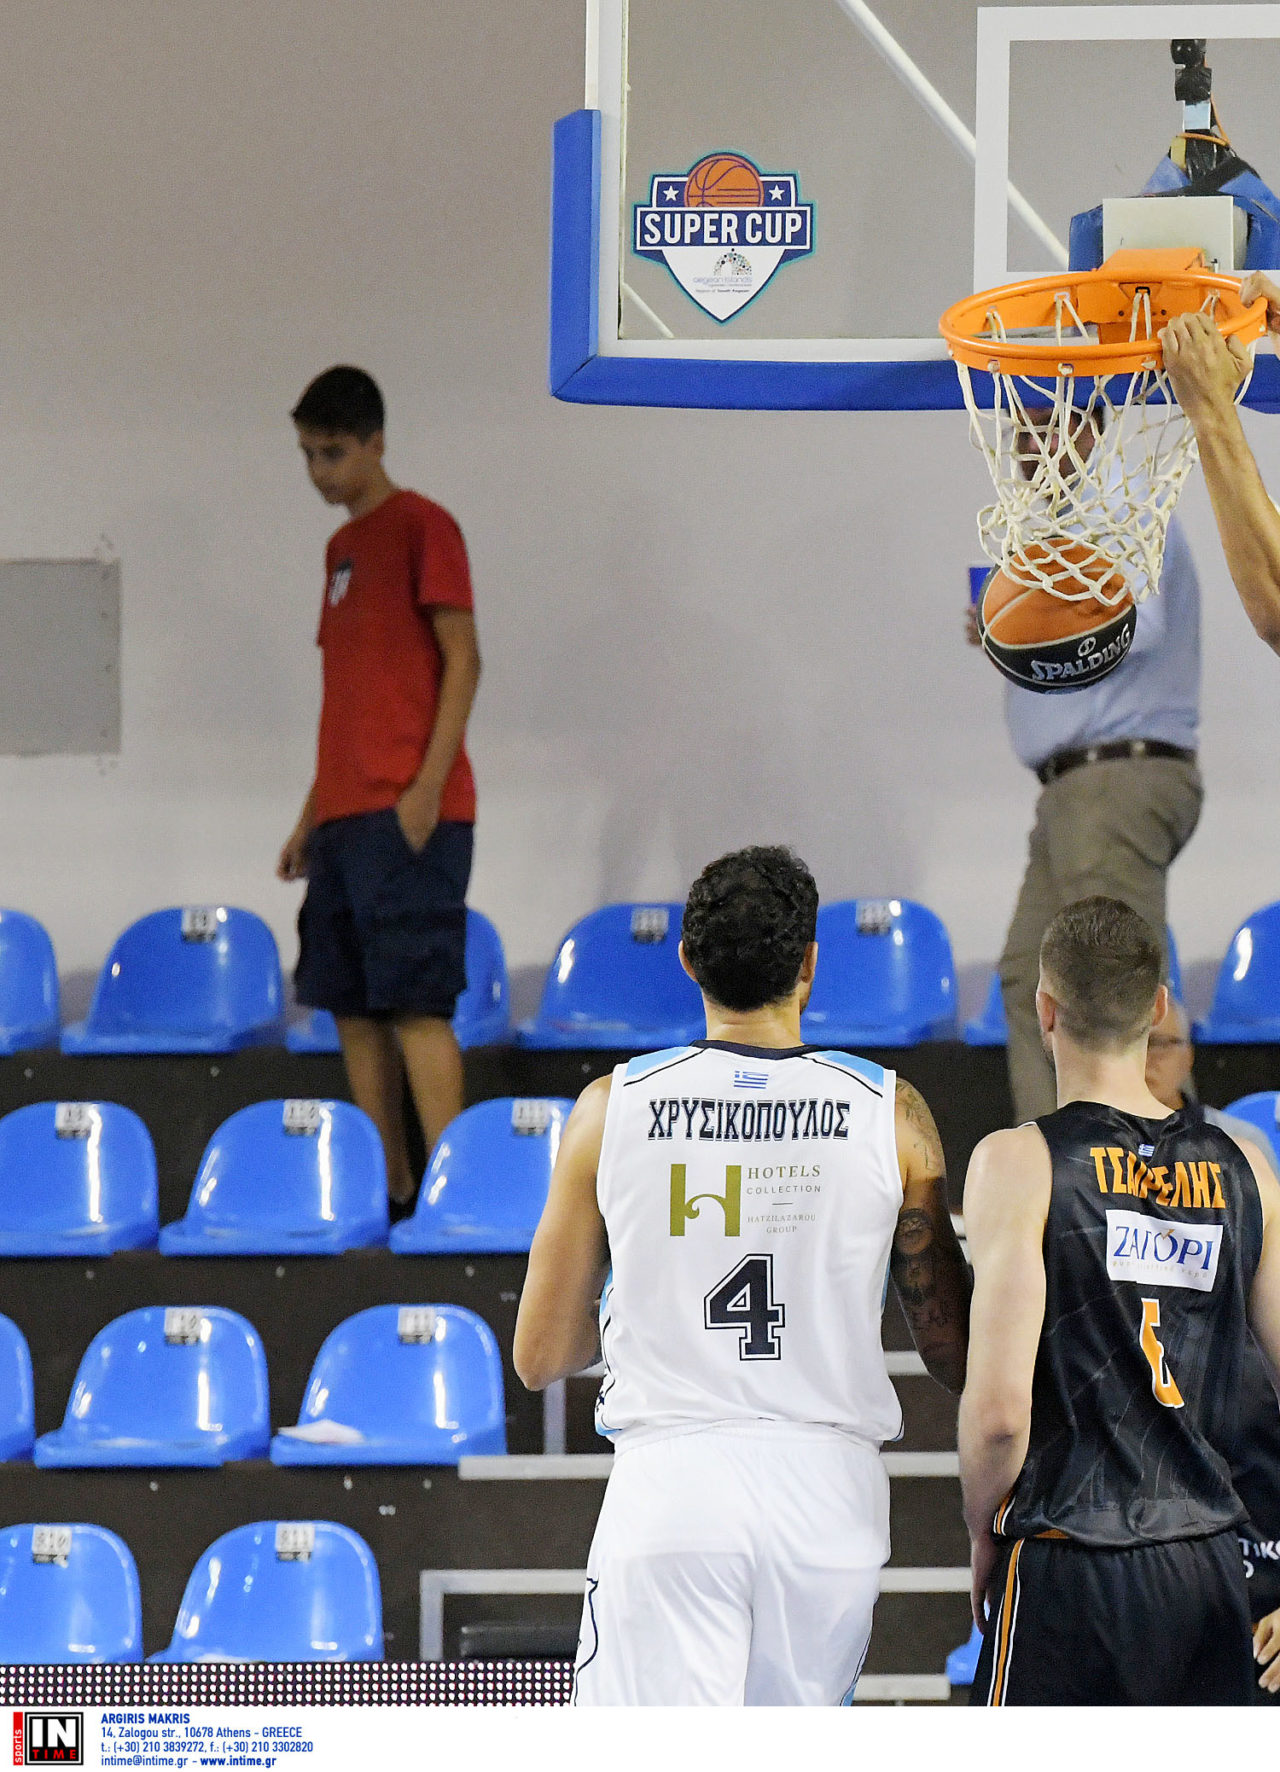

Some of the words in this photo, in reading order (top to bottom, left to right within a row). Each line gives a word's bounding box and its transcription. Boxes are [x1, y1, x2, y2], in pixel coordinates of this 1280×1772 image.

[643, 212, 738, 244] SUPER
[745, 212, 802, 244] CUP
[1030, 622, 1131, 681] SPALDING
[648, 1097, 850, 1142] ΧΡΥΣΙΚΟΠΟΥΛΟΣ
[747, 1164, 821, 1180] HOTELS
[746, 1184, 821, 1195] COLLECTION
[766, 1225, 798, 1234] GROUP
[703, 1253, 785, 1362] 4
